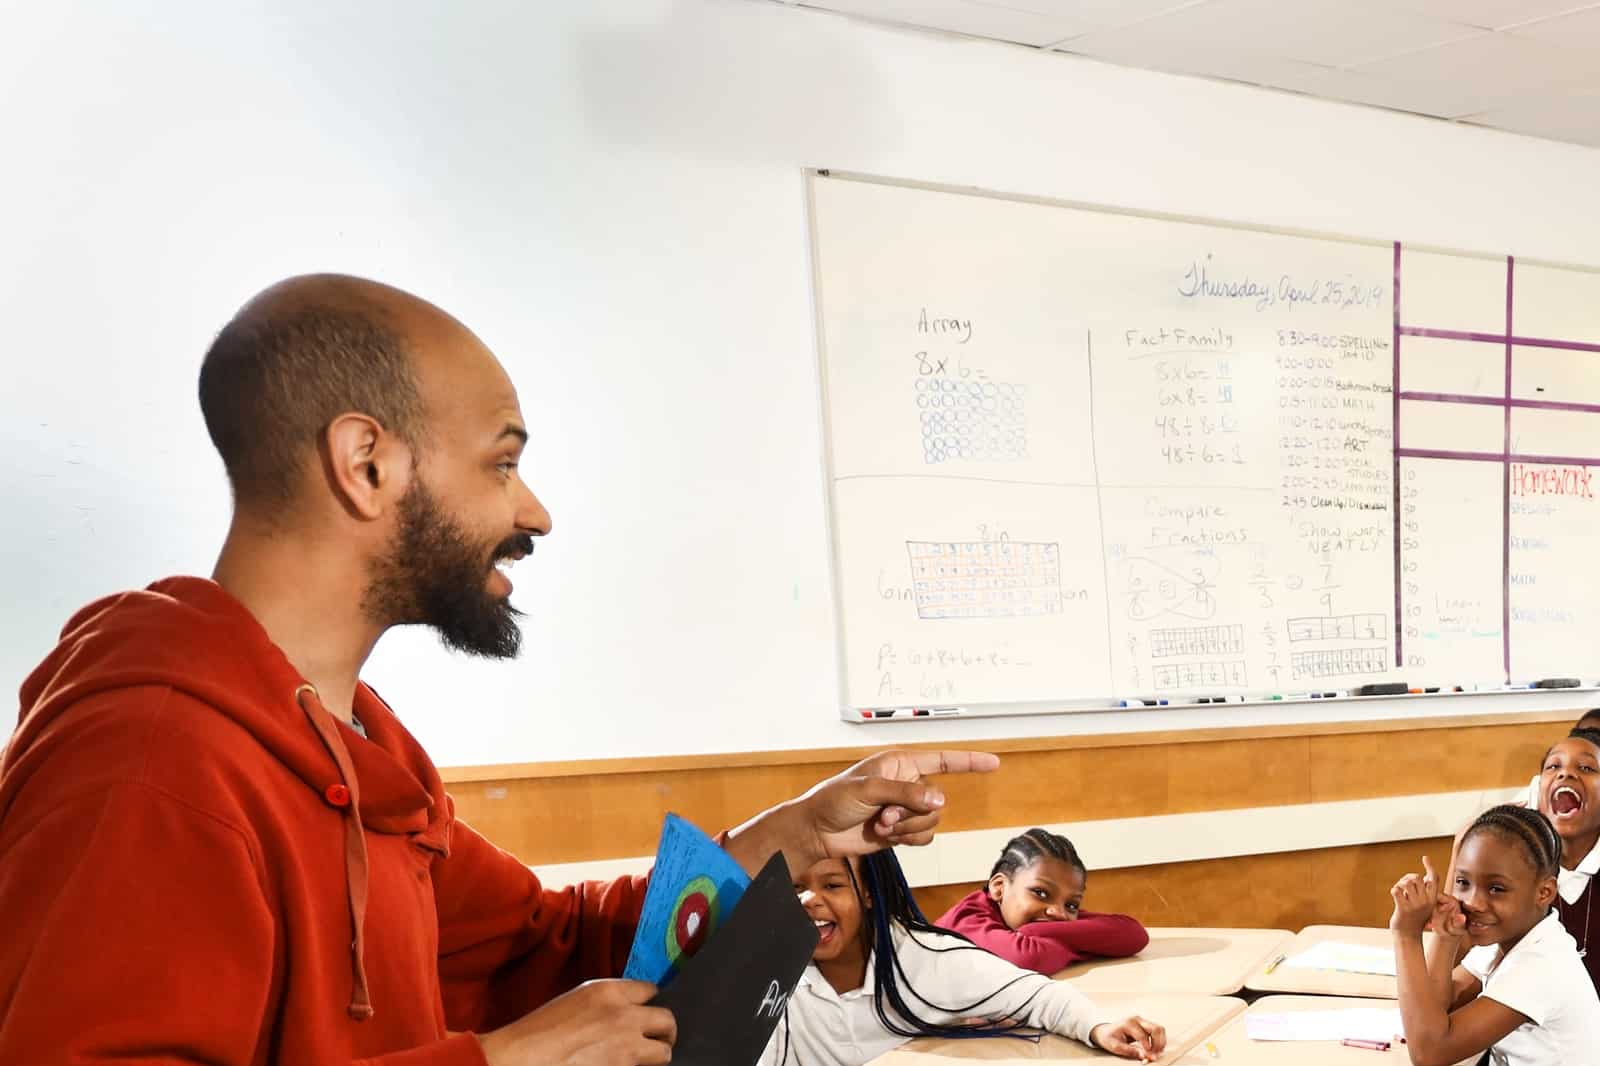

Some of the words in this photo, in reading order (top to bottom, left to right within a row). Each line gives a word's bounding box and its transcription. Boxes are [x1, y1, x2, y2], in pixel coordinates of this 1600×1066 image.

[1279, 274, 1320, 312] April
[917, 306, 972, 344] Array
[1124, 327, 1170, 347] Fact
[1173, 326, 1233, 348] Family
[1343, 435, 1370, 454] ART
[1512, 463, 1594, 500] Homework
[1297, 520, 1342, 539] Show
